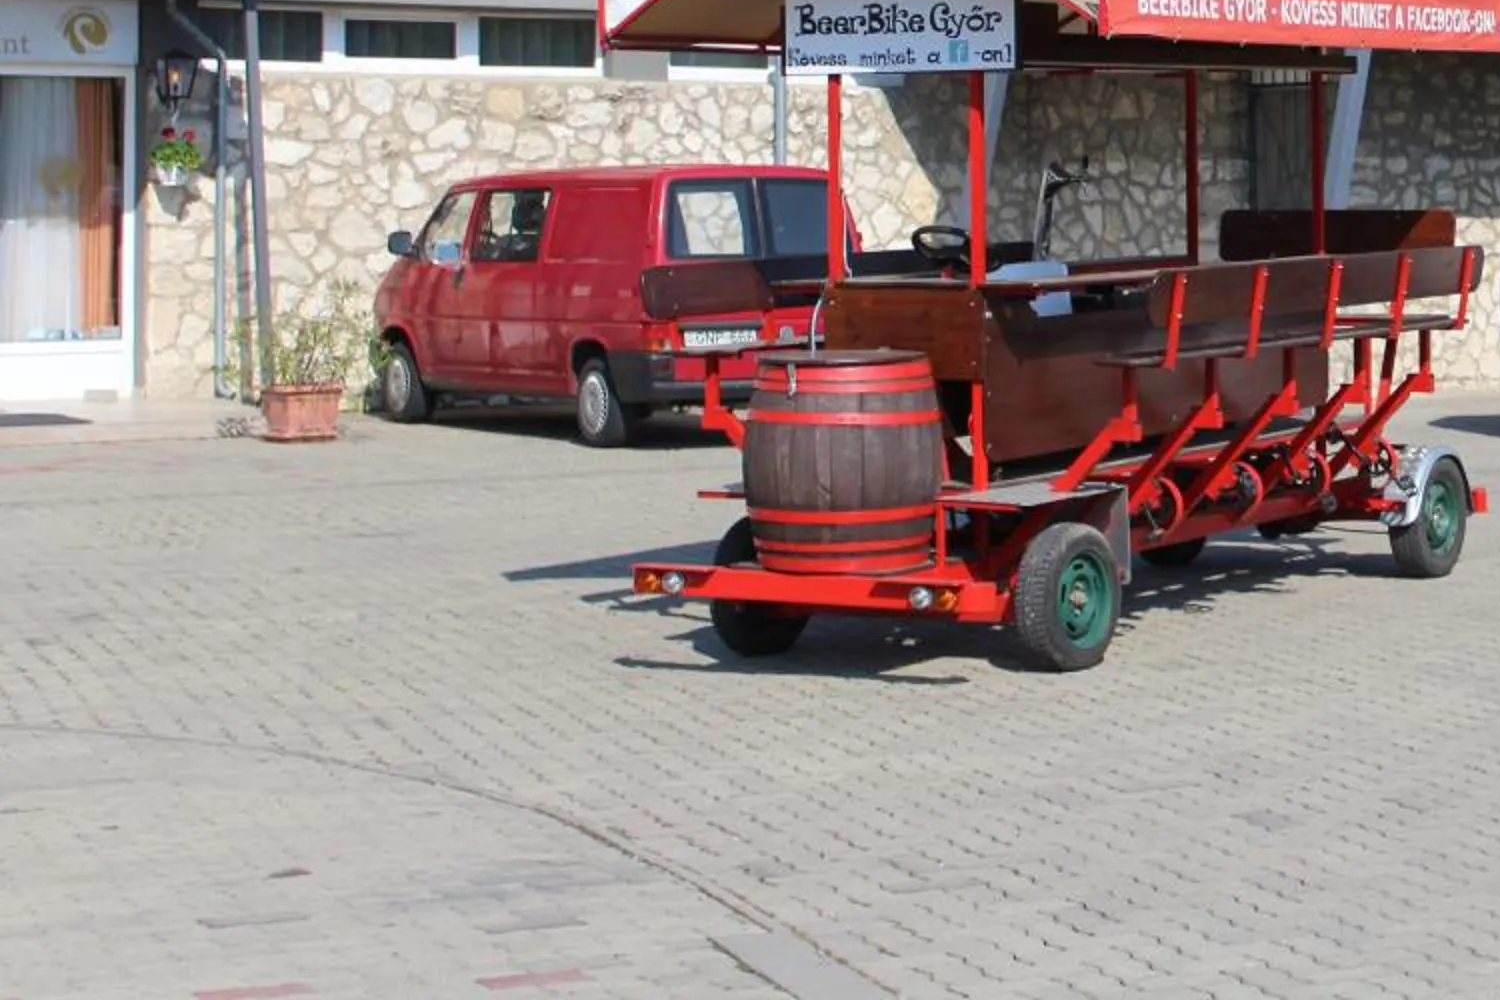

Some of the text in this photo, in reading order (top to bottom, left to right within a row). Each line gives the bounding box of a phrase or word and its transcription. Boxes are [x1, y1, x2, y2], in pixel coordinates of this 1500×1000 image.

[794, 2, 1003, 38] BeerBike Győr
[1341, 1, 1393, 30] MINKET
[1395, 4, 1405, 31] A
